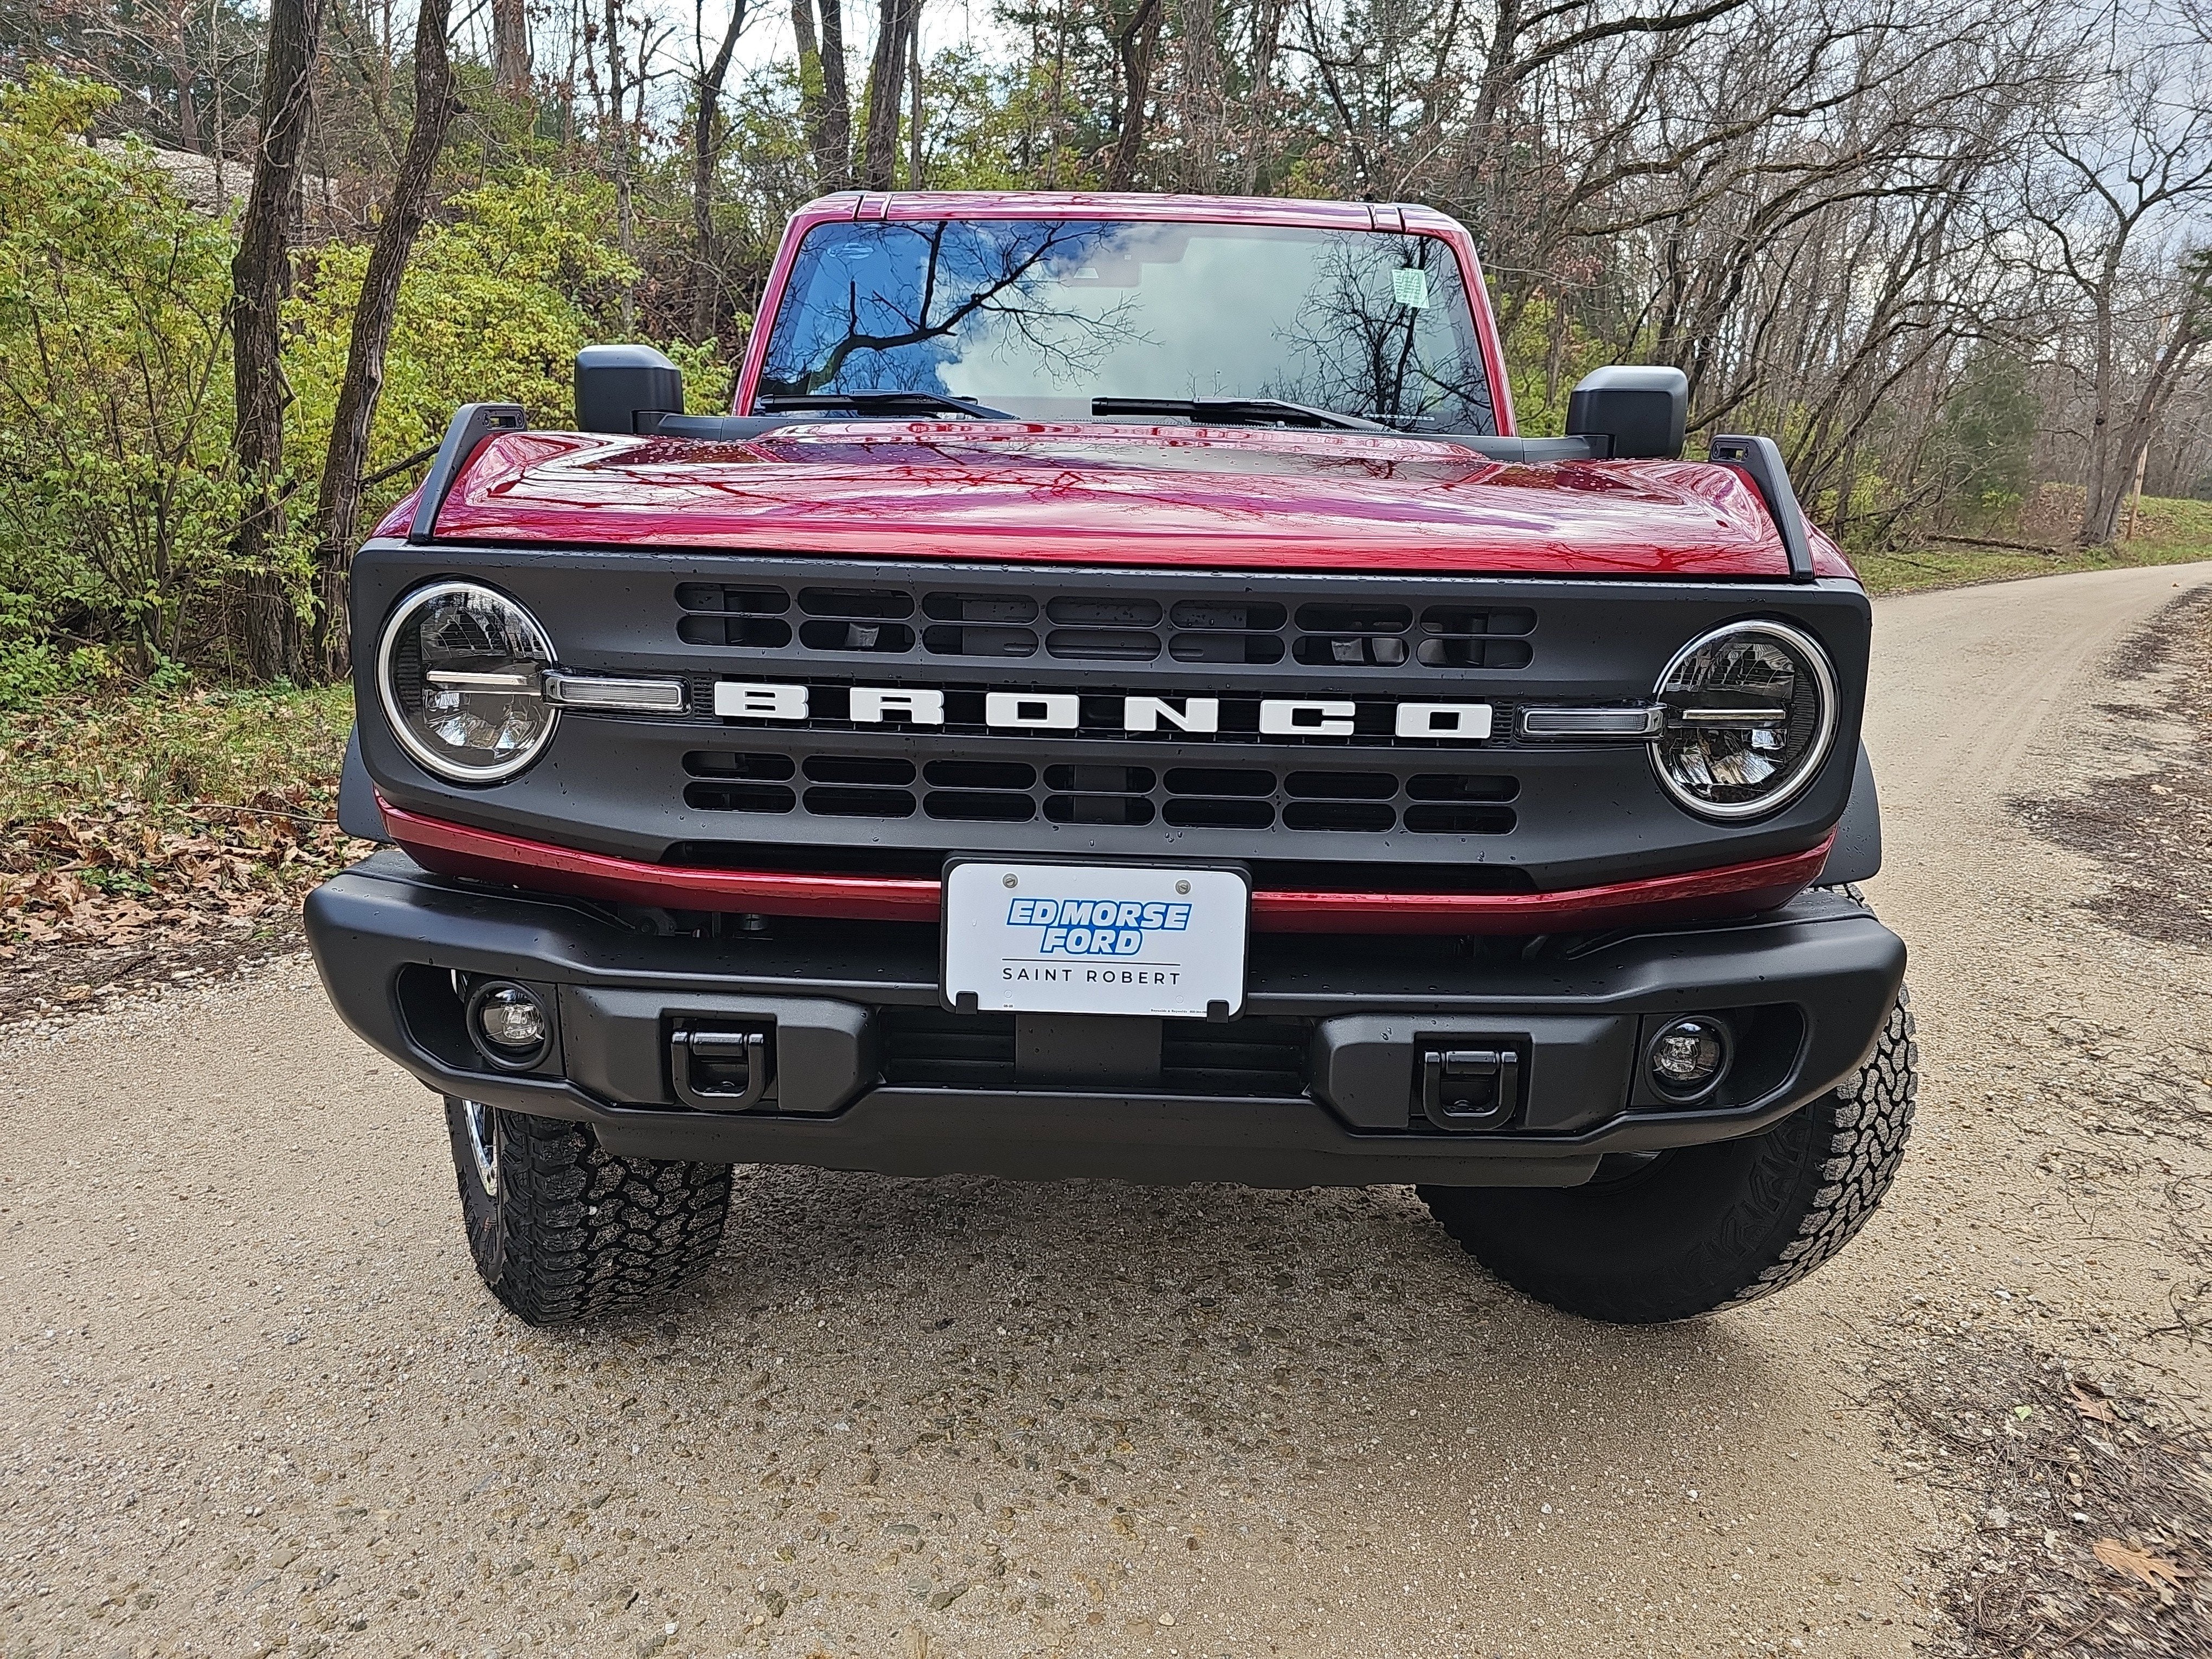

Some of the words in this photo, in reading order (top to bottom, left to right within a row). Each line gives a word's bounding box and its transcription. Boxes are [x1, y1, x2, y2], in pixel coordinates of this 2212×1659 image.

[1362, 413, 1435, 421] BRONCO
[713, 680, 1492, 739] BRONCO
[1007, 898, 1059, 926] ED
[1059, 899, 1192, 930] MORSE
[1040, 926, 1142, 955] FORD
[1002, 968, 1072, 981] SAINT
[1086, 970, 1181, 985] ROBERT
